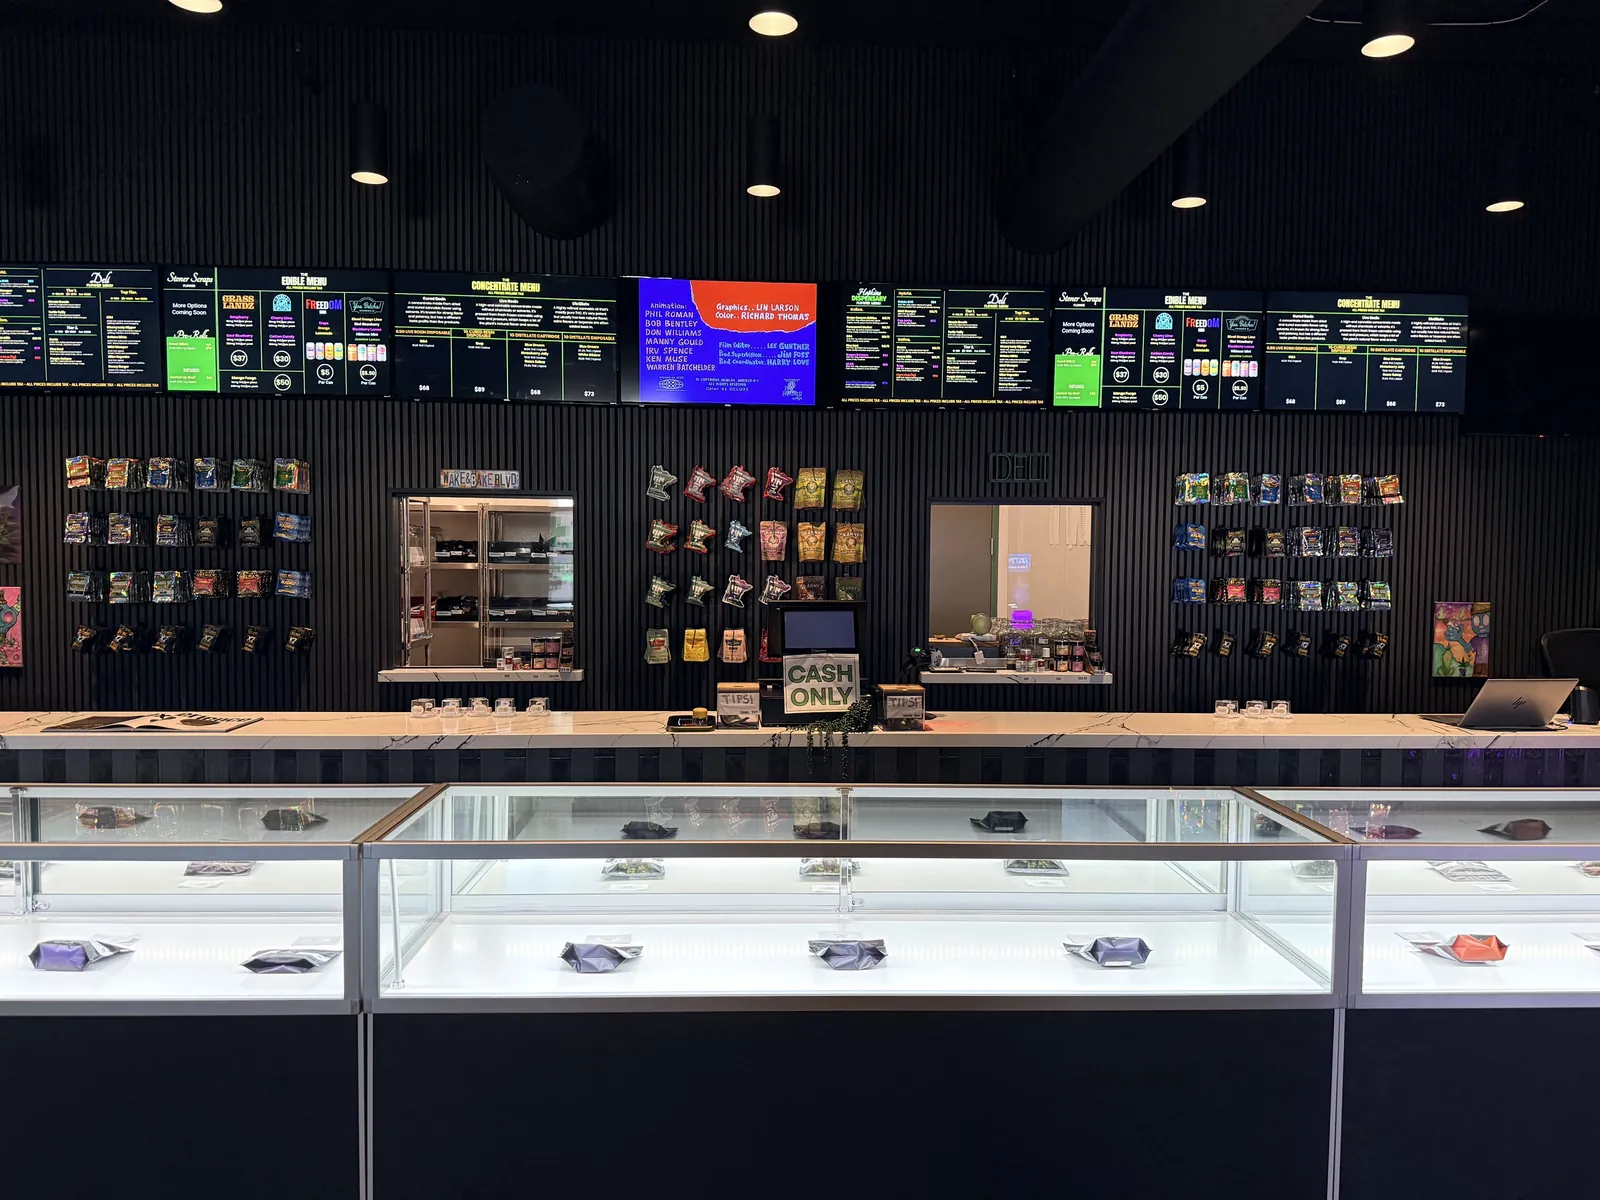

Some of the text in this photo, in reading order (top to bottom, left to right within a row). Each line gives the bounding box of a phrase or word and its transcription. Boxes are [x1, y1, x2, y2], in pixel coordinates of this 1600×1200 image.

[90, 271, 112, 284] Deli
[167, 272, 213, 286] Stoner Scraps
[282, 276, 327, 286] EDIBLE MENU
[472, 281, 540, 292] CONCENTRATE MENU
[987, 292, 1009, 304] Deli
[1059, 292, 1102, 305] Stoner Scraps
[1165, 296, 1207, 305] EDIBLE MENU
[1338, 298, 1400, 309] CONCENTRATE MENU
[306, 299, 342, 309] FREEDOM
[1186, 318, 1219, 327] FREEDOM
[996, 454, 1046, 480] DELI
[788, 664, 852, 683] CASH
[722, 694, 753, 704] TIPS!
[791, 687, 852, 706] ONLY
[889, 697, 918, 707] TIPS!
